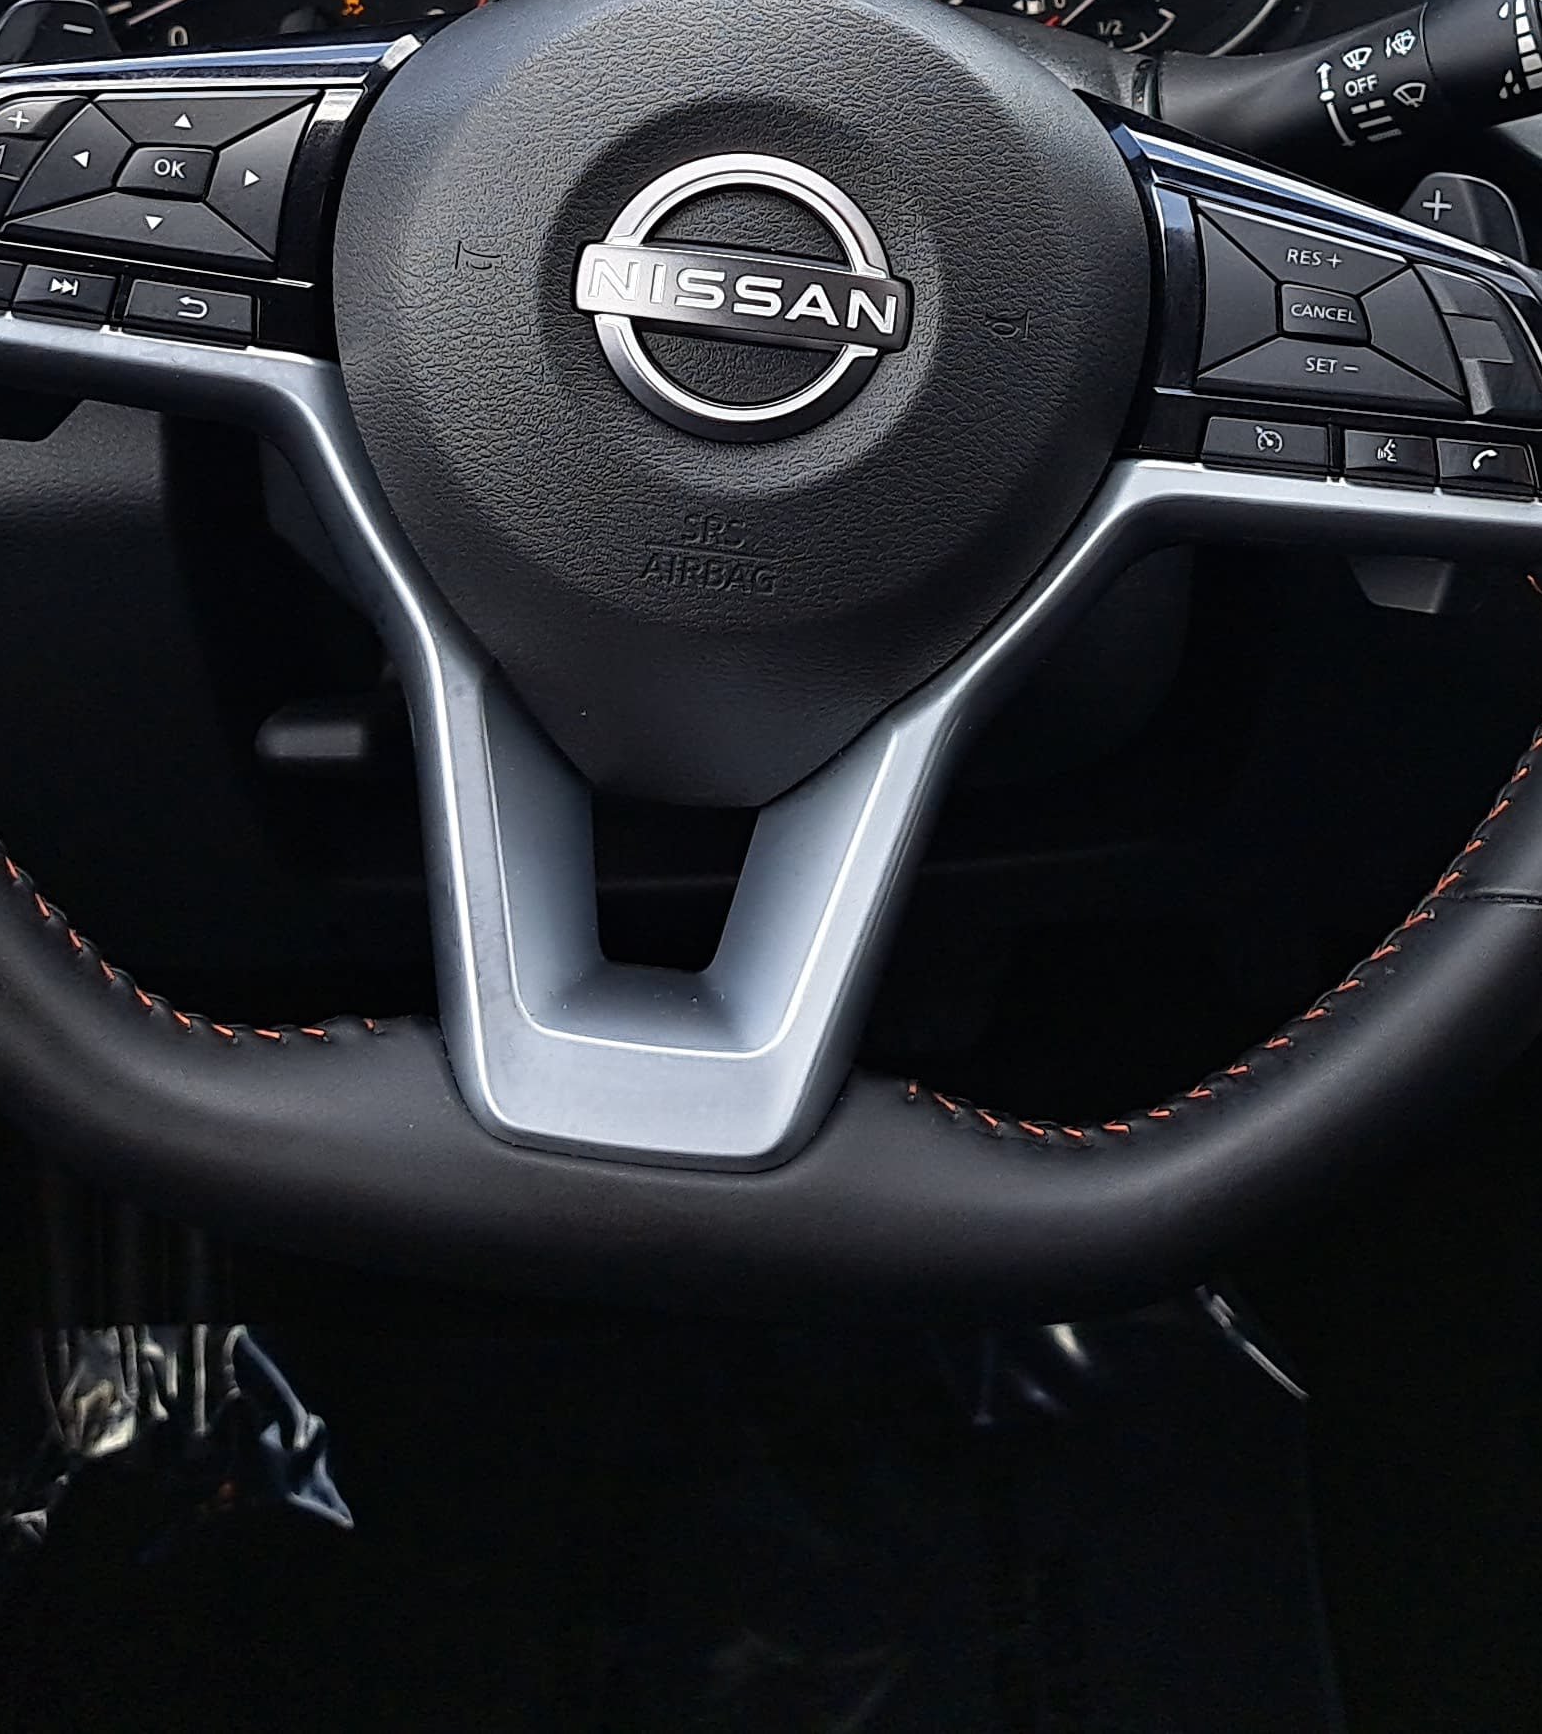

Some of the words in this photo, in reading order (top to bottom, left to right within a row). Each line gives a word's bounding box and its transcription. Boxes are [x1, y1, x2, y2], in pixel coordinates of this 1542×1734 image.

[1098, 19, 1123, 37] 1/2
[1344, 75, 1379, 98] OFF
[153, 159, 187, 179] OK
[587, 257, 897, 336] NISSAN
[1290, 303, 1357, 325] CANCEL
[680, 513, 747, 549] SRS
[641, 553, 777, 597] AIRBAG
